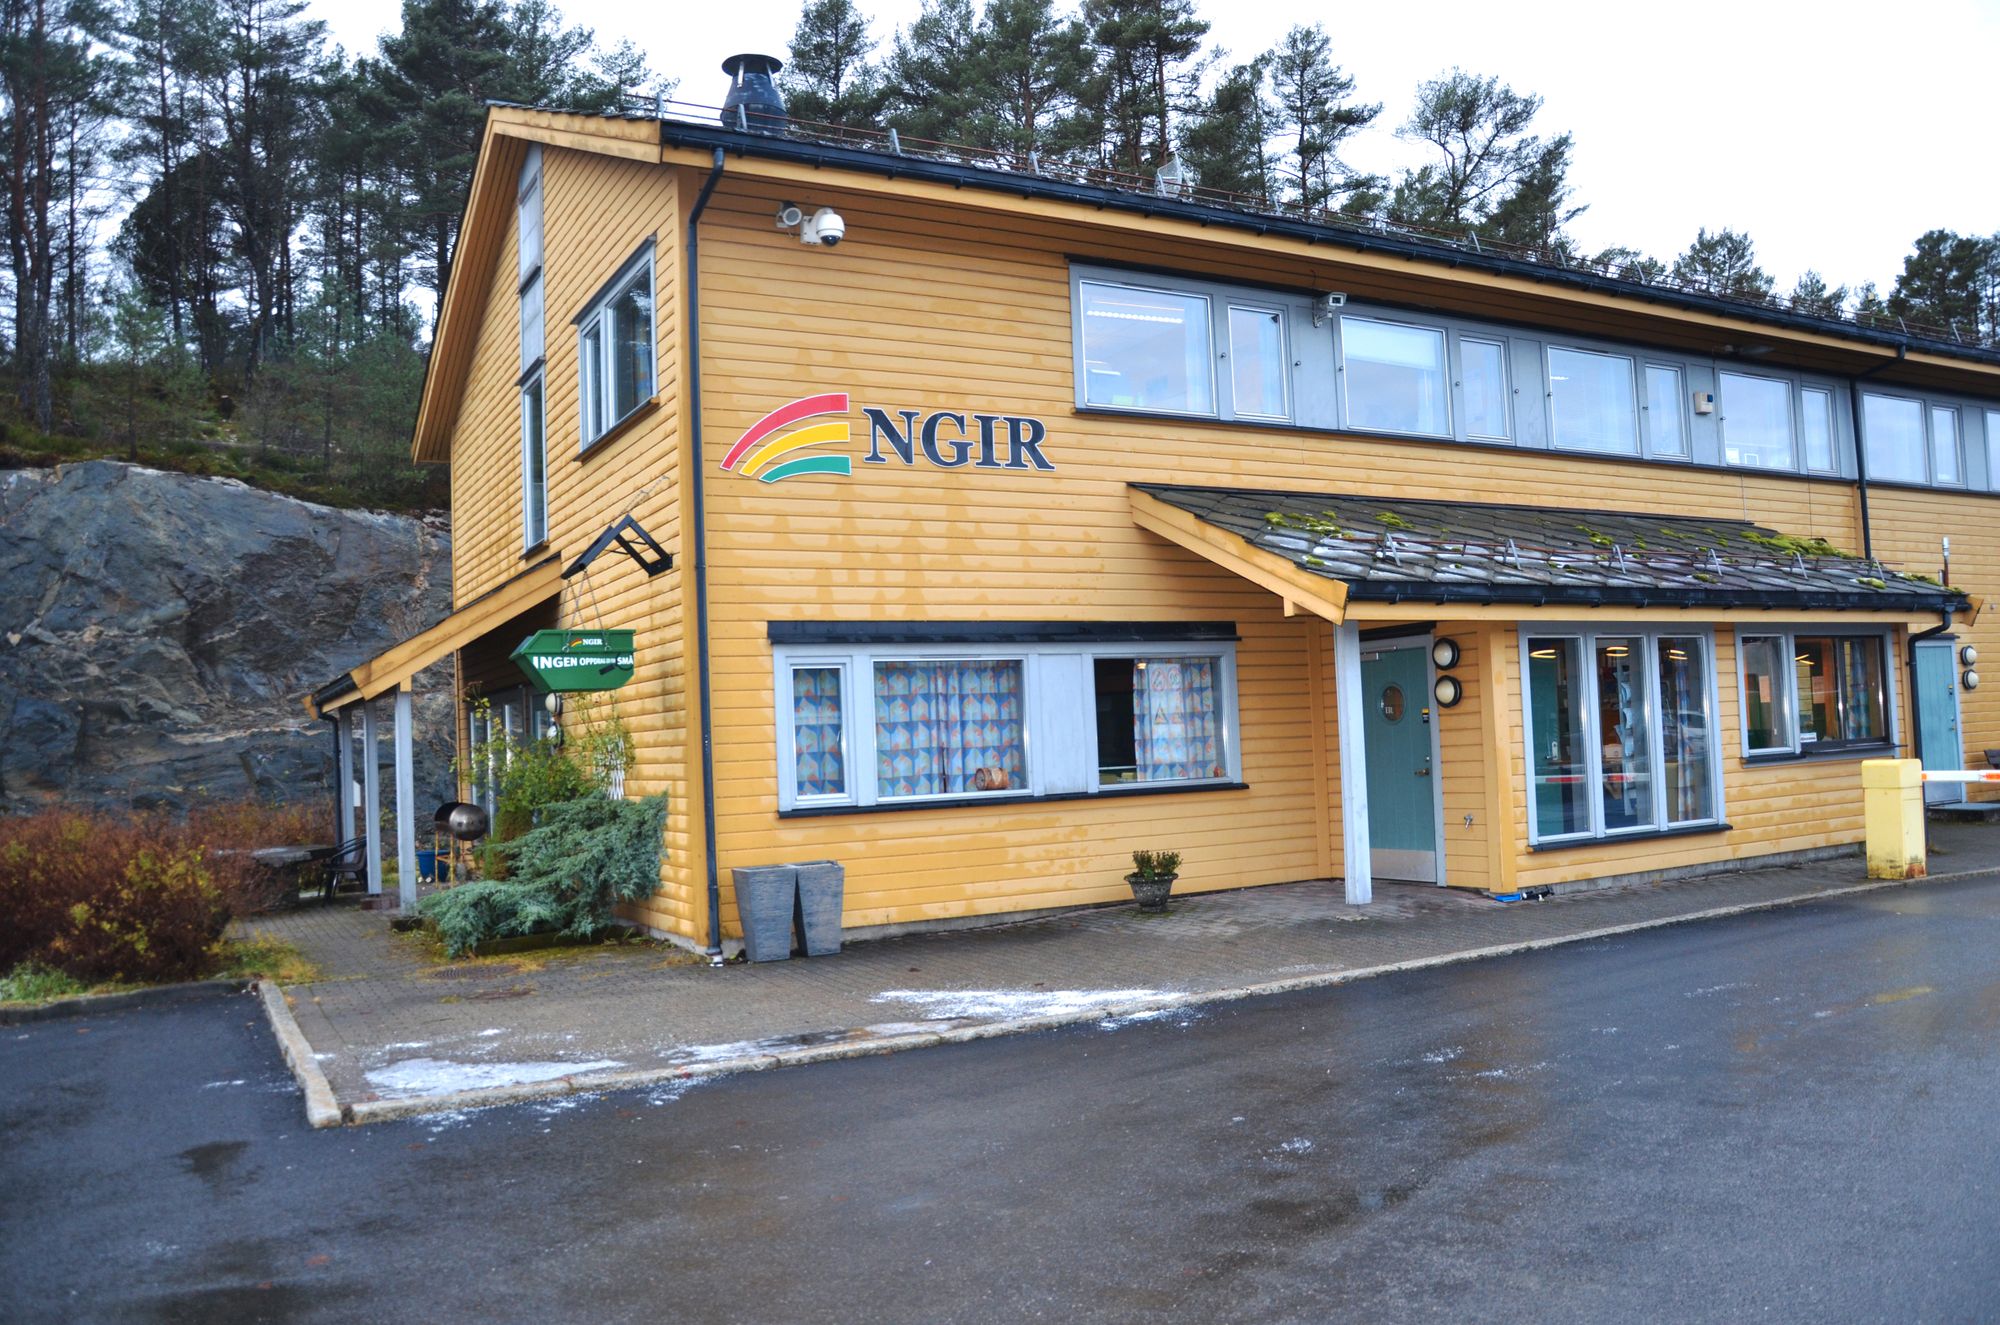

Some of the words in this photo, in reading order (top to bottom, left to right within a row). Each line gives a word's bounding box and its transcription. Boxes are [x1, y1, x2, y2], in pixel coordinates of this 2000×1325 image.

[862, 407, 1056, 471] NGIR
[532, 656, 578, 669] INGEN
[617, 655, 634, 665] SMÅ
